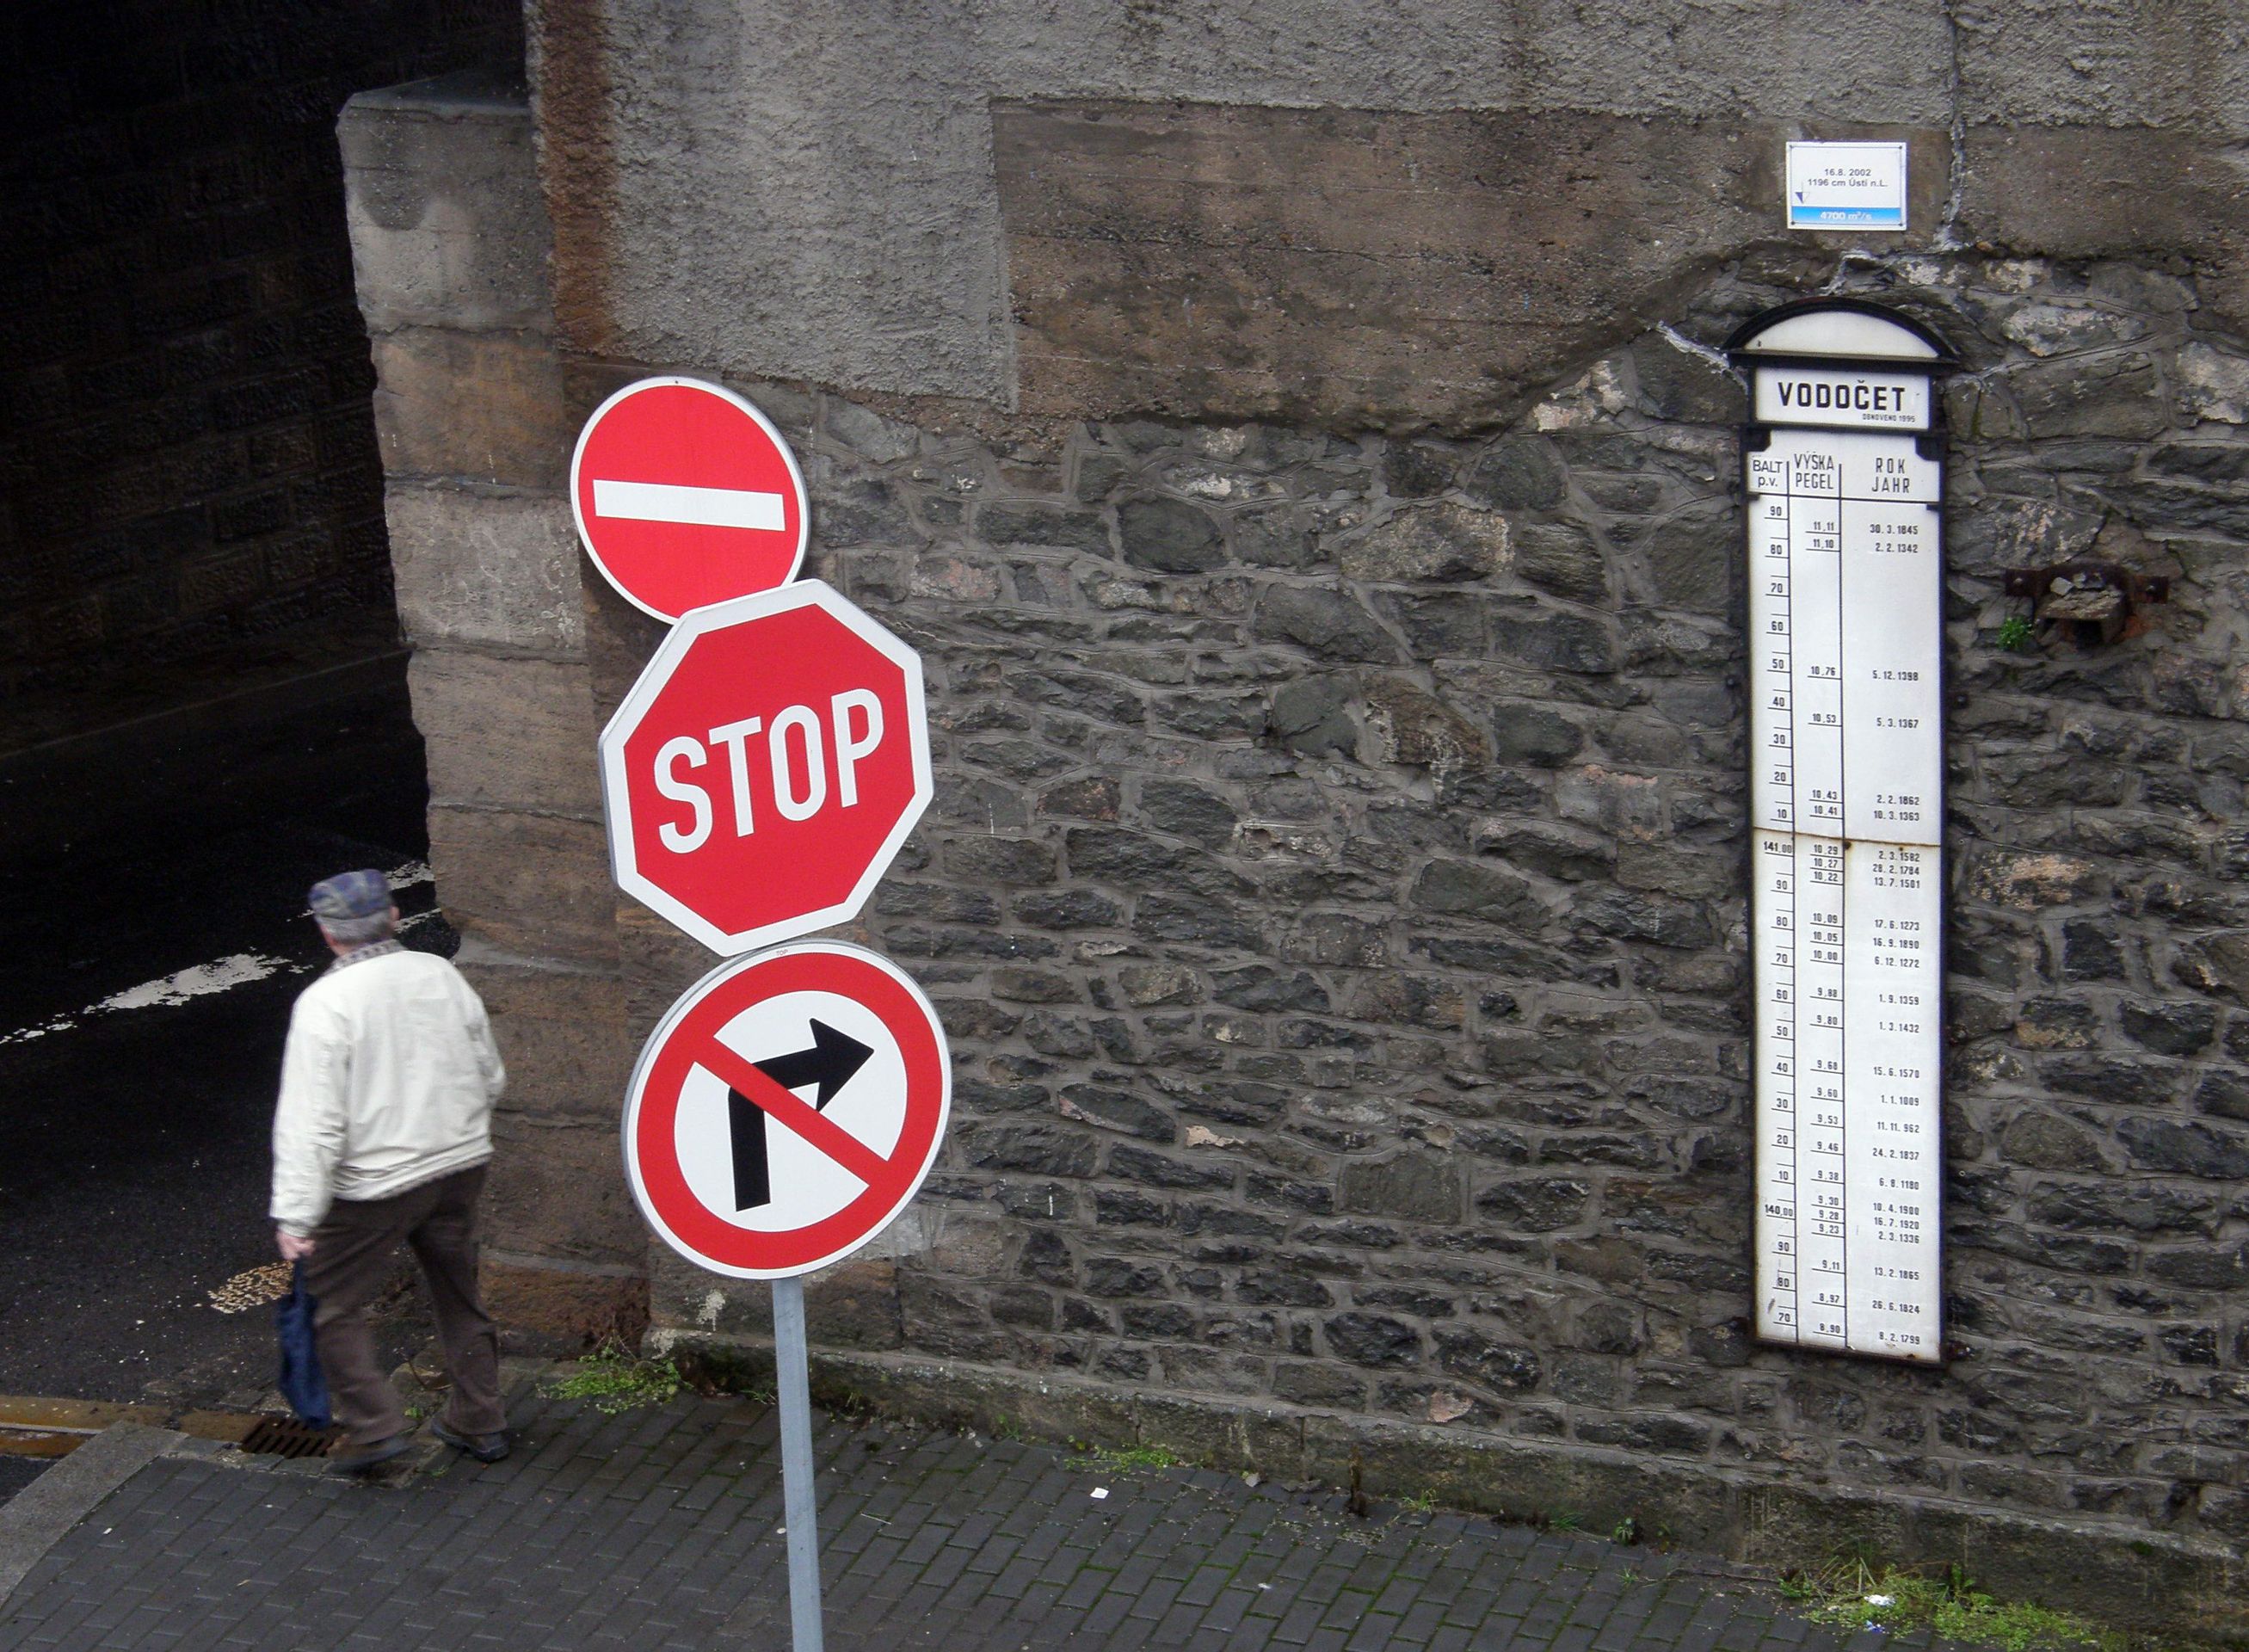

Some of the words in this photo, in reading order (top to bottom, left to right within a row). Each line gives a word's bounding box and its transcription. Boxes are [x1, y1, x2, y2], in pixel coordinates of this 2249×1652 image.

[1849, 168, 1871, 176] 2002
[1808, 178, 1829, 187] 1196
[1820, 211, 1845, 220] 4700
[1778, 379, 1906, 411] VODOČET
[1753, 459, 1783, 473] BALT
[1876, 457, 1906, 475] ROK
[1758, 476, 1778, 488] p.v.
[1796, 472, 1833, 490] PEGEL
[1871, 476, 1910, 494] JAHR
[1770, 506, 1782, 516] 90
[1770, 545, 1783, 555] 80
[1771, 583, 1783, 593] 70
[1771, 621, 1784, 632] 60
[1771, 659, 1784, 669] 50
[1772, 696, 1785, 707] 40
[1773, 734, 1785, 745] 30
[652, 687, 884, 854] STOP
[1774, 772, 1786, 782] 20
[1777, 809, 1787, 819] 10
[1776, 879, 1788, 890] 90
[1776, 916, 1788, 927] 80
[1776, 952, 1788, 964] 70
[1776, 989, 1789, 1000] 60
[1776, 1026, 1789, 1037] 50
[1776, 1063, 1789, 1072] 40
[1776, 1099, 1789, 1109] 30
[1777, 1135, 1789, 1144] 20
[1778, 1171, 1789, 1180] 10
[1778, 1242, 1790, 1252] 90
[1777, 1278, 1790, 1288] 80
[1778, 1312, 1790, 1322] 70
